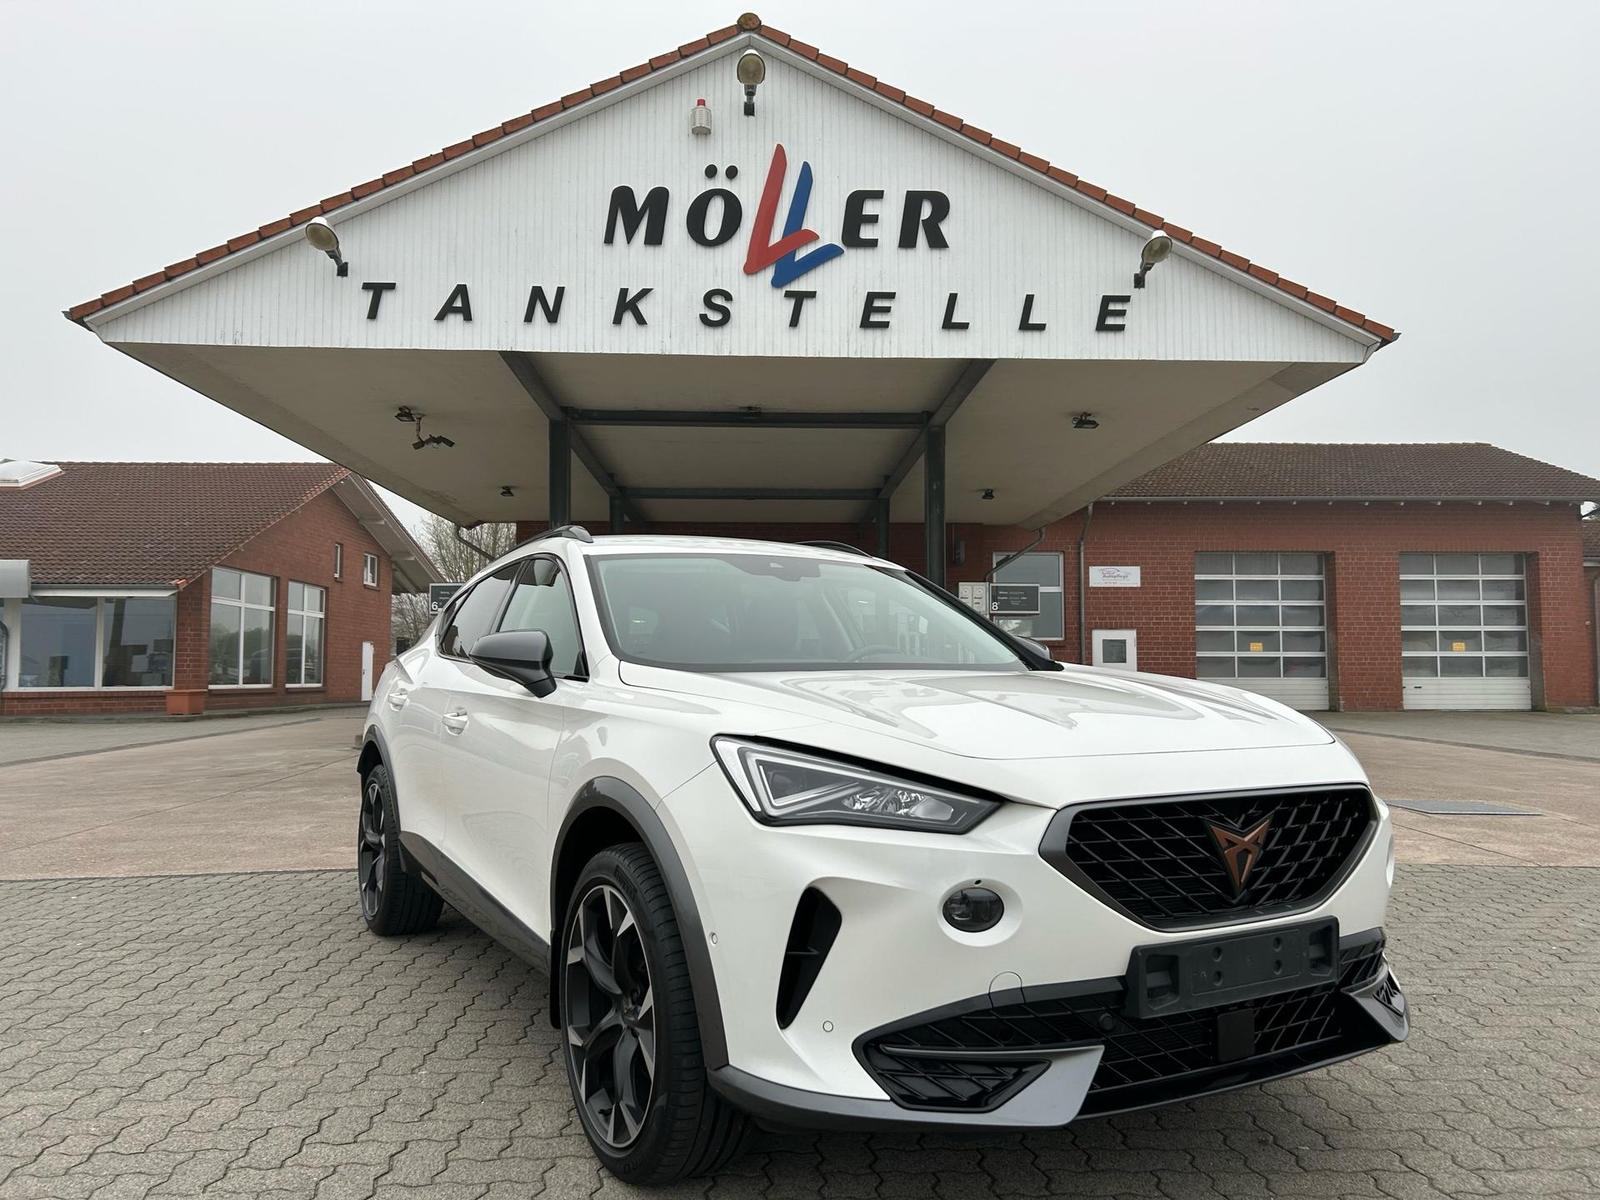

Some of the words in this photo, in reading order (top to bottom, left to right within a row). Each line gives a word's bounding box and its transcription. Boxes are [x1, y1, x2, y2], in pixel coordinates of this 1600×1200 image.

[604, 143, 951, 288] MÖLLER
[359, 281, 1132, 332] TANKSTELLE
[431, 601, 438, 610] 6
[992, 602, 999, 611] 8
